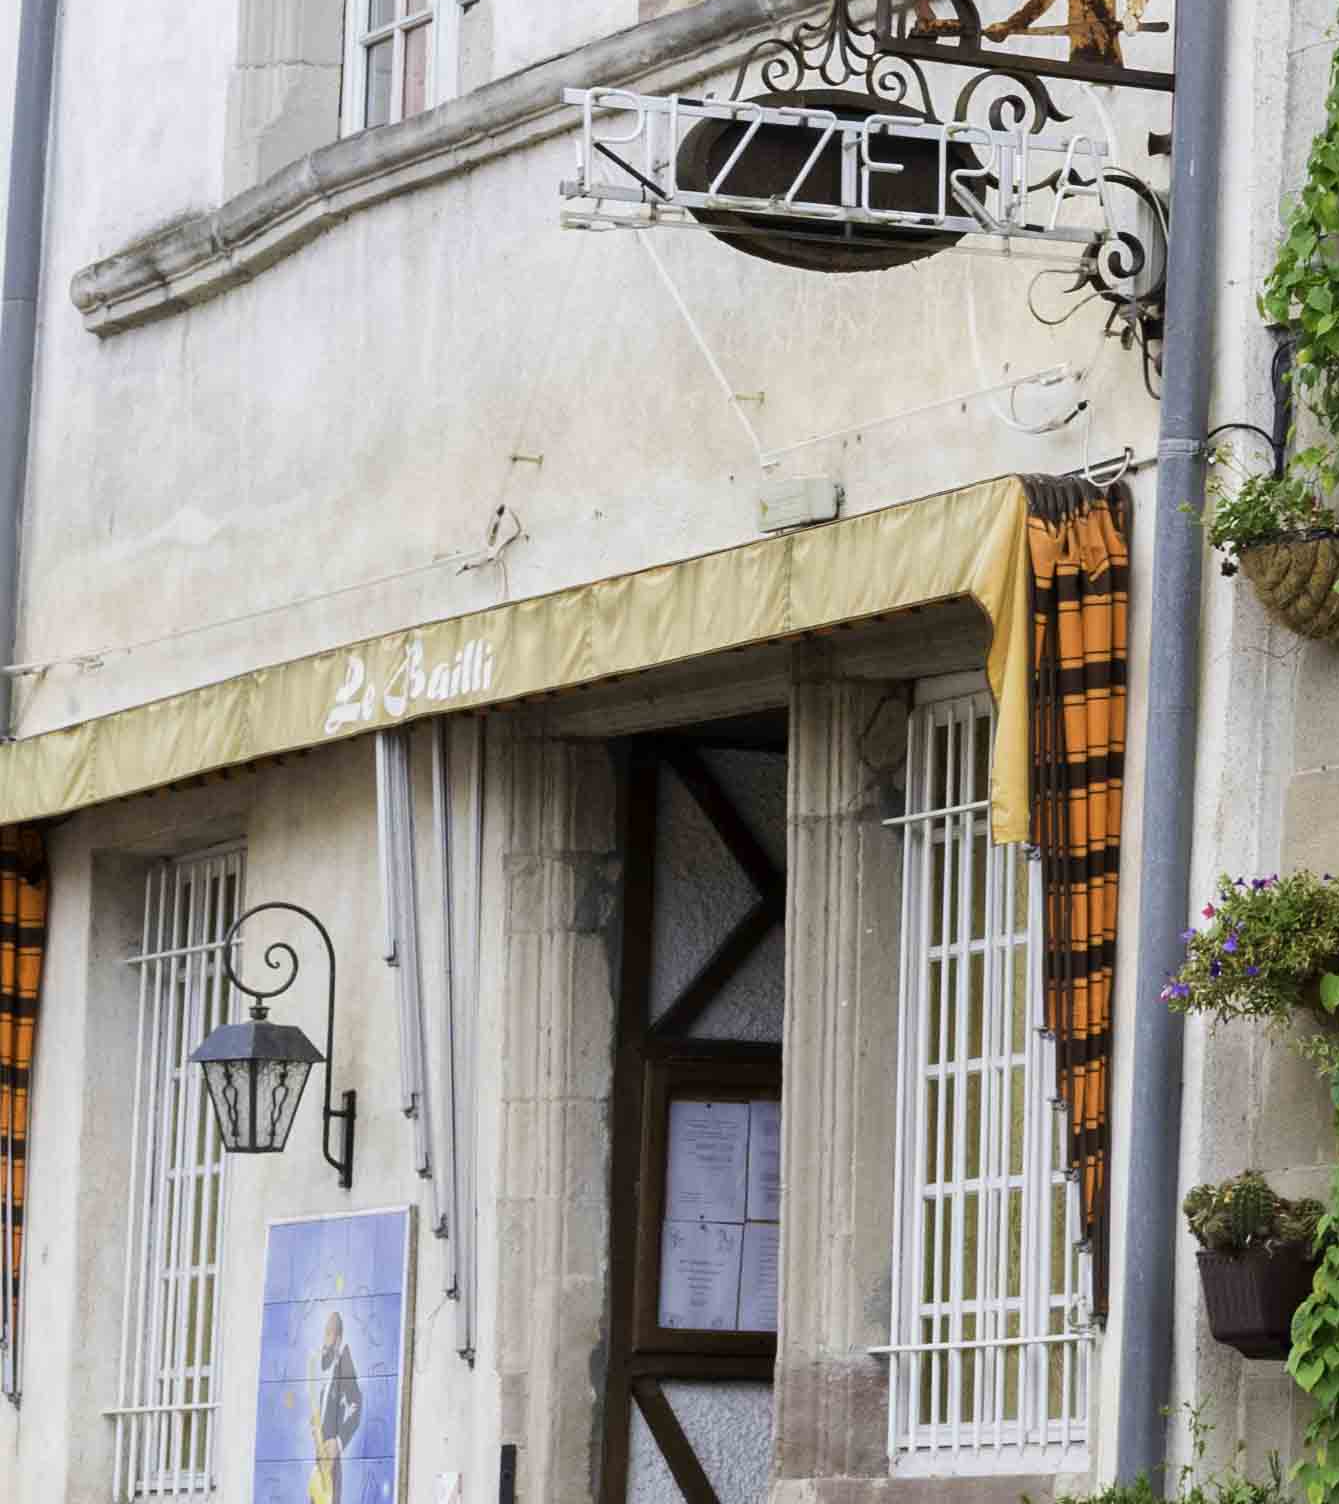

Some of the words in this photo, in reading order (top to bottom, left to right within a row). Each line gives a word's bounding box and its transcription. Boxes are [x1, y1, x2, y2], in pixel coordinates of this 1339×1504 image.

[583, 87, 1119, 241] PIZZERIA
[323, 655, 376, 736] Le
[383, 629, 494, 718] Bailli
